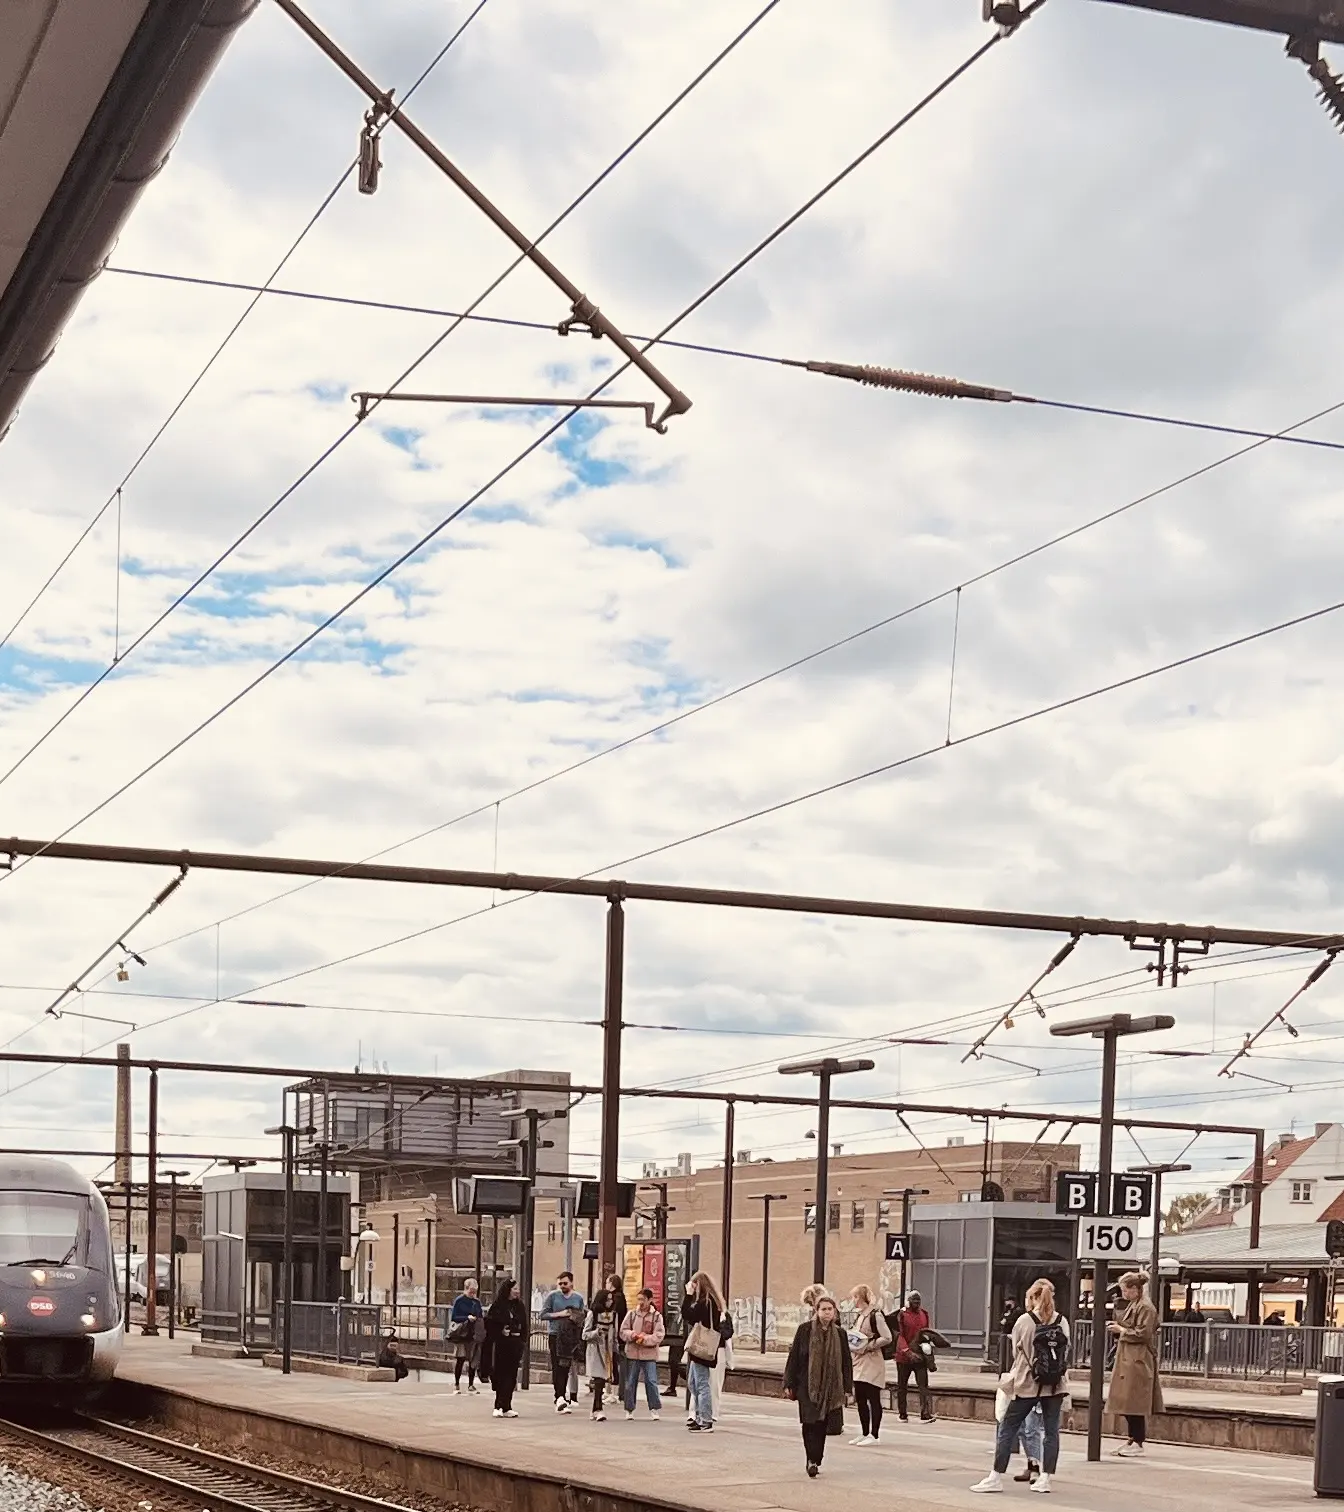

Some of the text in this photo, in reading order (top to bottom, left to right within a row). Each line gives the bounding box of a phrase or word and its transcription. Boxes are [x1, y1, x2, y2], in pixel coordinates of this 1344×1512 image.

[1068, 1183, 1086, 1209] B
[1124, 1185, 1142, 1211] B
[891, 1240, 905, 1257] A
[1086, 1225, 1133, 1251] 150
[30, 1302, 53, 1310] DSB
